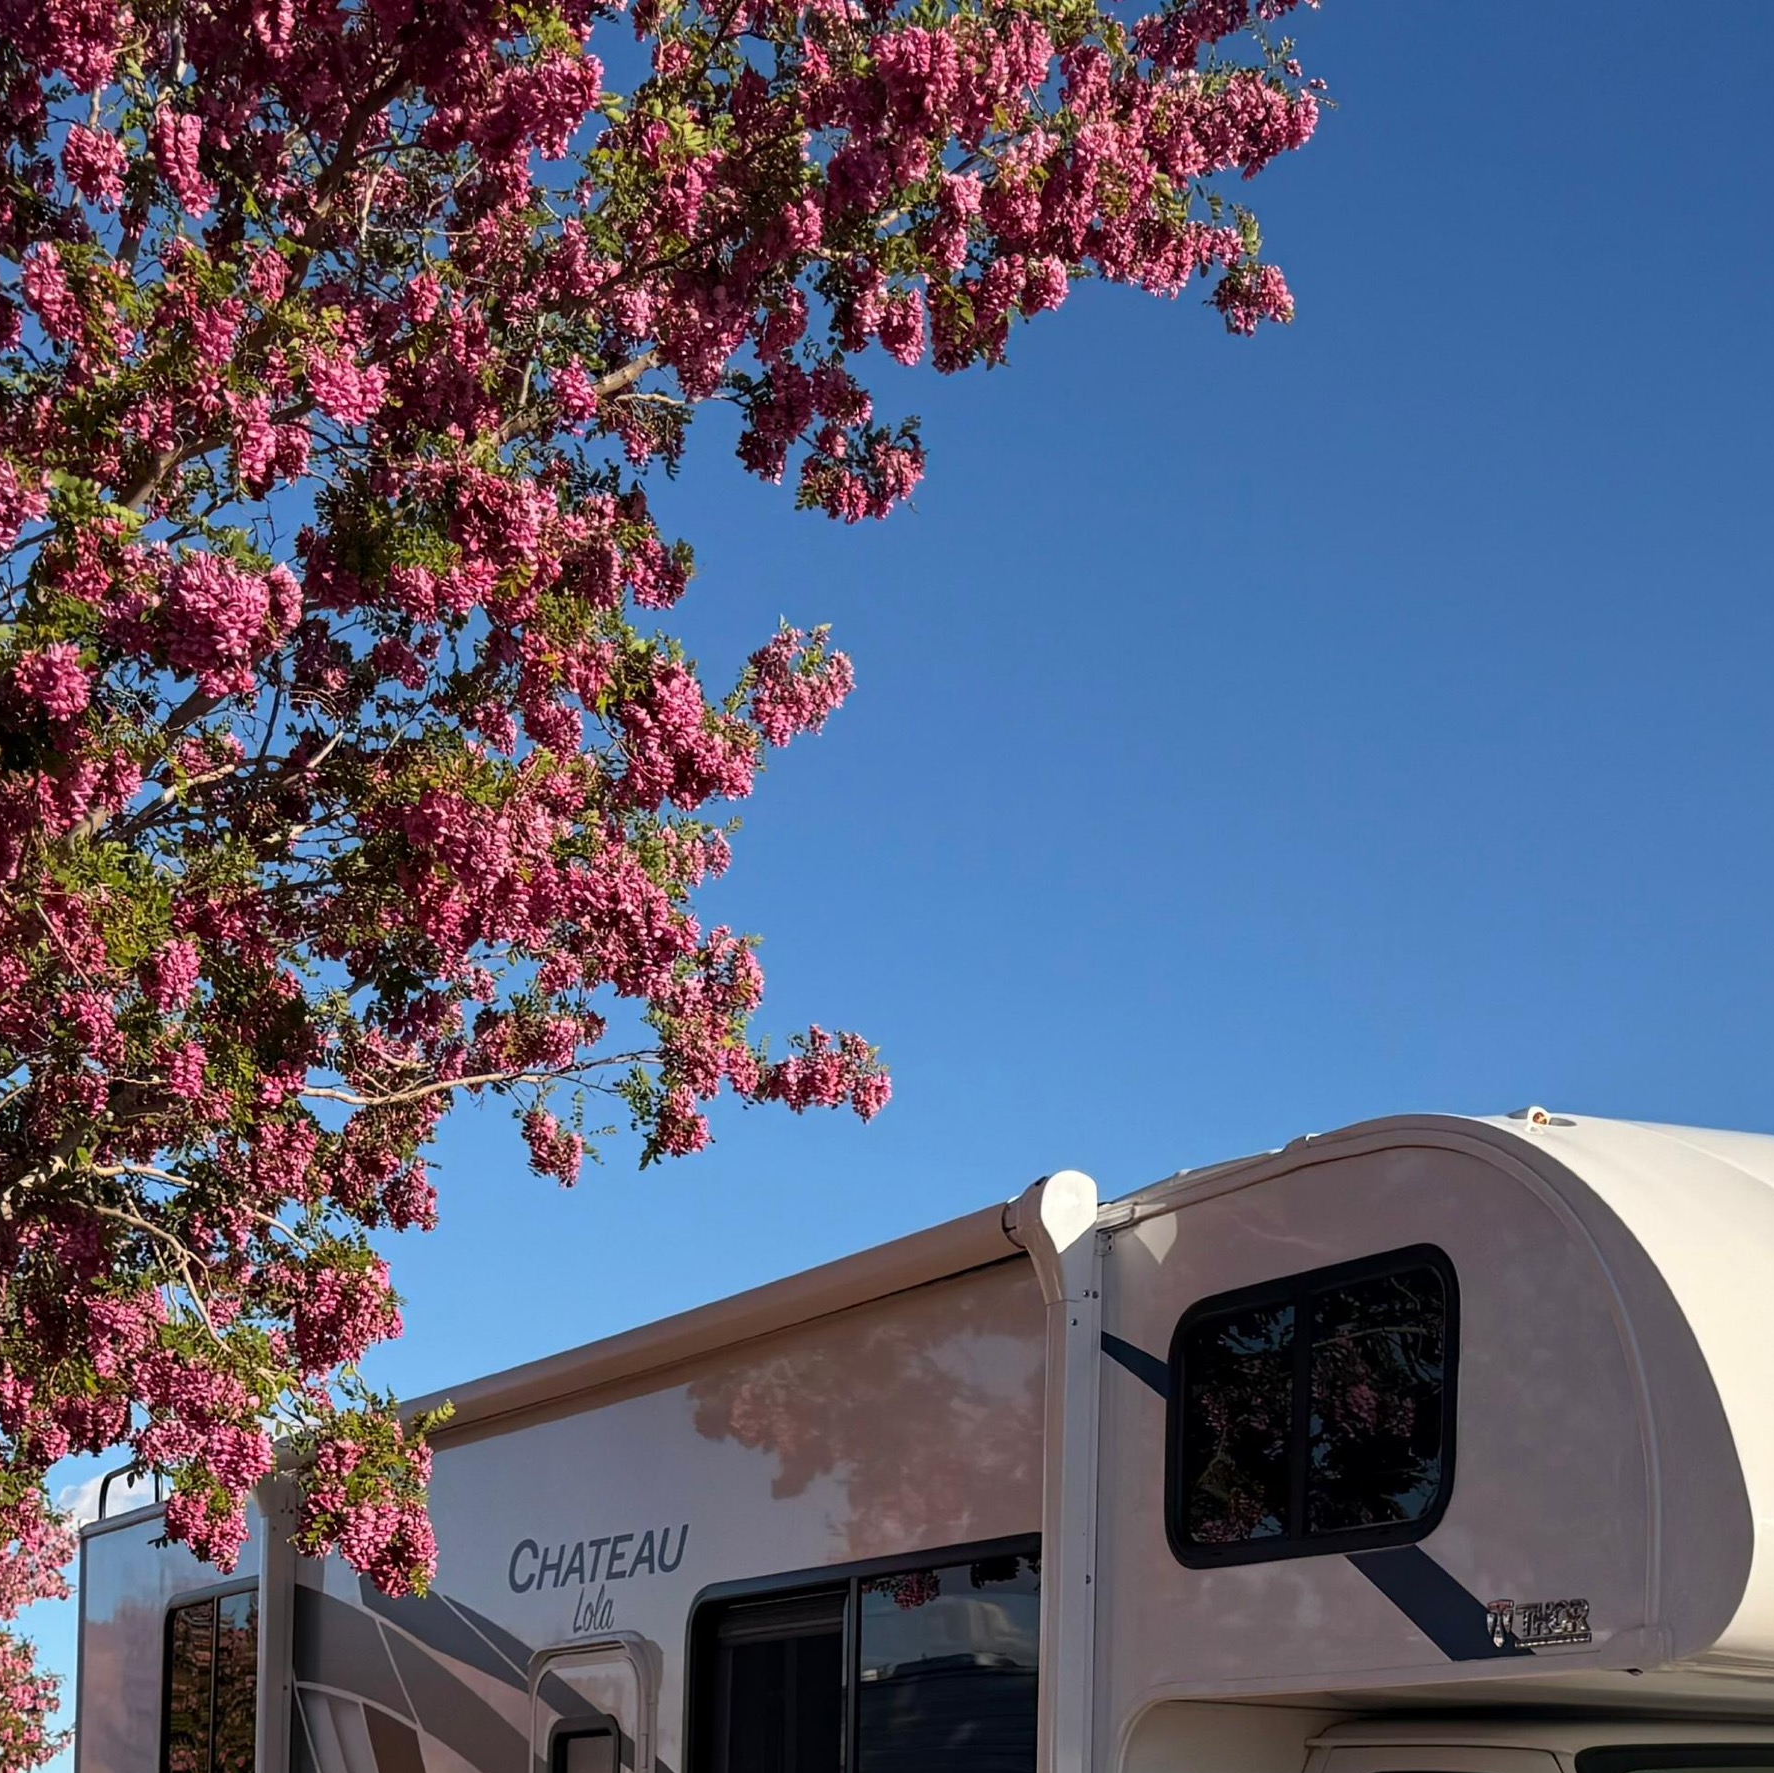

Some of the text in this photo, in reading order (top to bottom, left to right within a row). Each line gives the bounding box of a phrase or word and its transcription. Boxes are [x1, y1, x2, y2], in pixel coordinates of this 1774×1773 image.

[508, 1523, 689, 1594] CHATEAU
[572, 1583, 615, 1634] Lola
[1515, 1598, 1591, 1637] THOR
